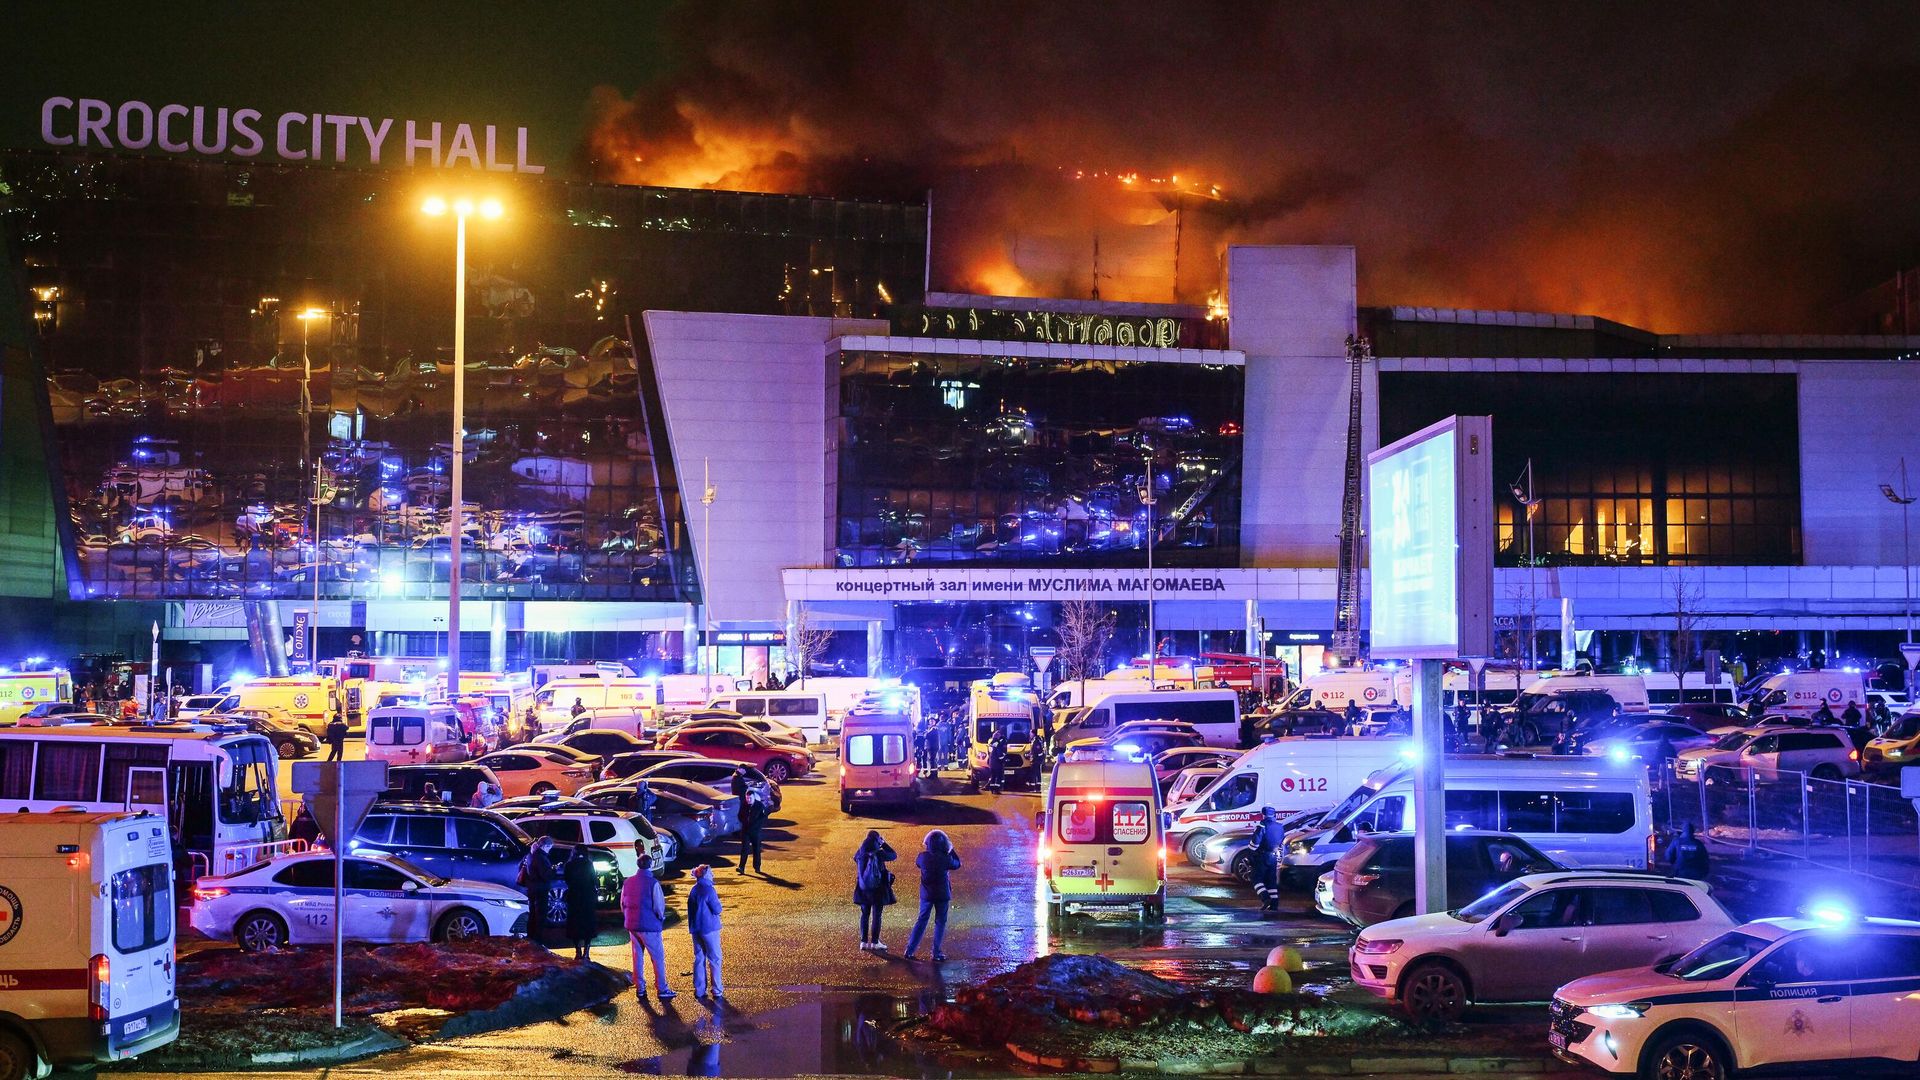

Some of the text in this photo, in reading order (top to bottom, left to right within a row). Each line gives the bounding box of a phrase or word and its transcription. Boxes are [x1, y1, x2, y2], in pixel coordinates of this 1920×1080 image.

[41, 96, 546, 175] CROCUS CITY HALL
[836, 578, 1226, 595] концертный зал имени МУСЛИМА МАГОМАЕВА
[1330, 691, 1345, 699] 112
[1803, 691, 1817, 699] 112
[1298, 777, 1328, 792] 112
[1114, 810, 1146, 827] 112
[1221, 813, 1250, 821] СКОРАЯ
[1113, 828, 1146, 836] СПАСЕНИЯ
[304, 913, 328, 926] 112
[1769, 986, 1818, 999] ПОЛИЦИЯ
